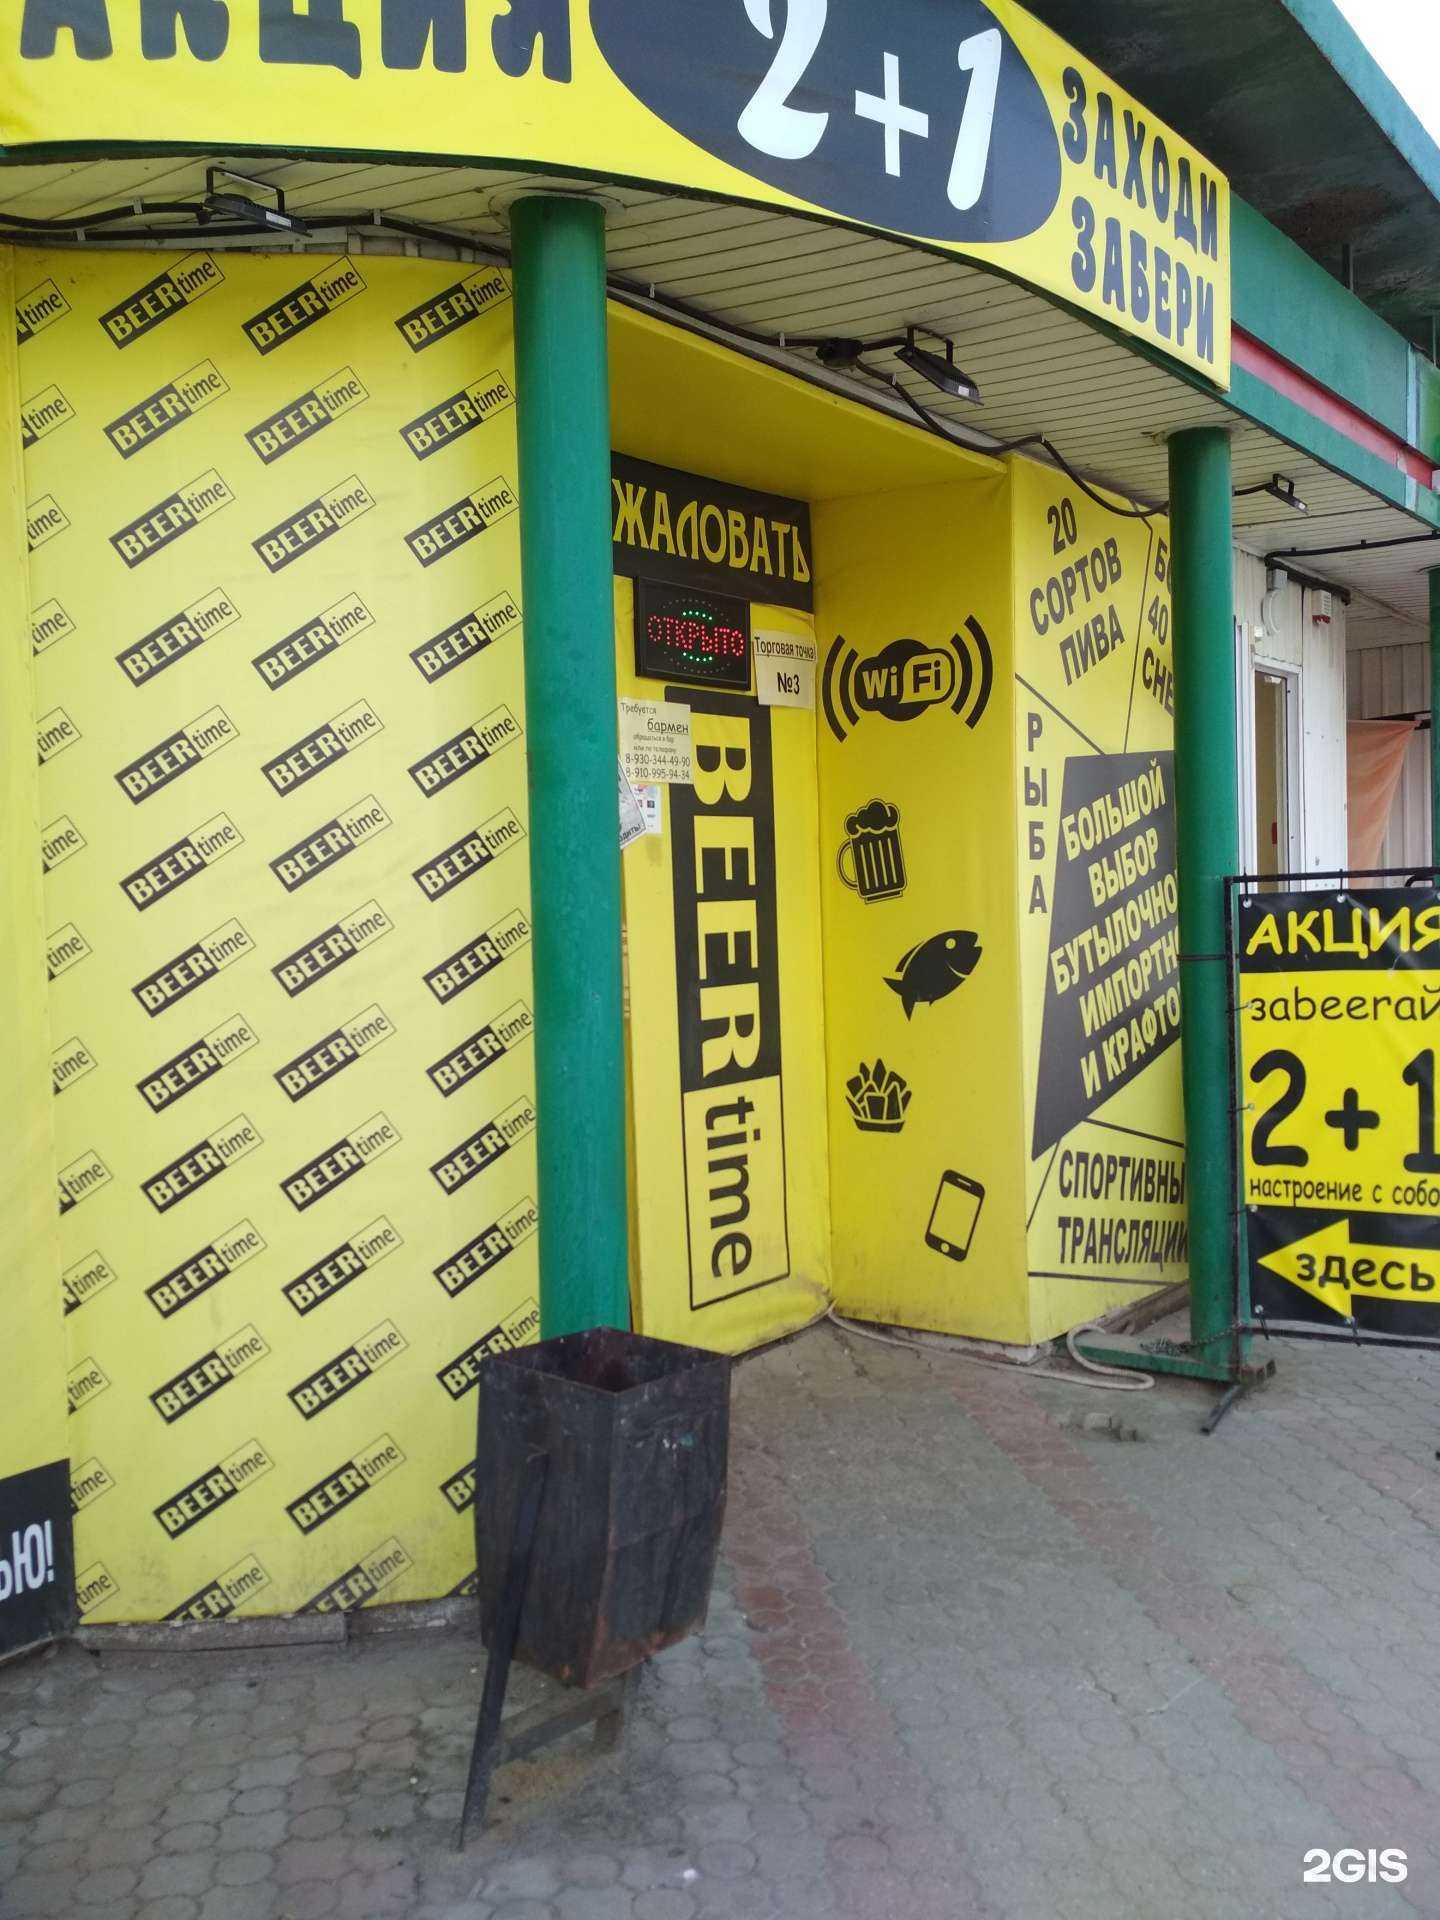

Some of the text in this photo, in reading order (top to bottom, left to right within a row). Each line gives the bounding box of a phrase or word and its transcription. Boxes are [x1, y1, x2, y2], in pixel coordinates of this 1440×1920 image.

[1063, 66, 1218, 262] ЗАХОДИ
[104, 257, 221, 344] BEERtime
[247, 263, 363, 351] BEERtime
[401, 274, 508, 348] BEERtime
[1071, 196, 1214, 364] ЗАБЕРИ
[109, 366, 226, 454] BEERtime
[250, 373, 365, 460] BEERtime
[405, 377, 515, 455] BEERtime
[115, 476, 231, 563] BEERtime
[258, 483, 372, 568] BEERtime
[410, 484, 516, 563] BEERtime
[612, 478, 811, 583] ЖАЛОВАТЬ
[1047, 498, 1077, 556] 20
[1030, 537, 1122, 636] СОРТОВ
[121, 595, 237, 682] BEERtime
[258, 600, 372, 686] BEERtime
[415, 598, 520, 678] BEERtime
[647, 615, 744, 656] ОТКРЫТО
[754, 636, 795, 657] Торговая
[1060, 604, 1124, 686] ПИВА
[620, 702, 657, 716] Требуется
[647, 717, 689, 734] бармен
[777, 672, 800, 695] №3
[120, 713, 235, 800] BEERtime
[267, 708, 380, 792] BEERtime
[413, 712, 519, 793] BEERtime
[274, 802, 388, 887] BEERtime
[1024, 713, 1047, 914] РЫБА
[1062, 758, 1166, 861] БОЛЬШОЙ
[125, 820, 241, 907] BEERtime
[418, 815, 522, 897] BEERtime
[1088, 827, 1159, 907] ВЫБОР
[137, 925, 252, 1013] BEERtime
[276, 907, 391, 992] BEERtime
[428, 915, 528, 999] BEERtime
[1051, 870, 1178, 995] БУТЫЛОЧНО
[1245, 906, 1440, 959] АКЦИЯ
[690, 711, 763, 1281] BEERtime
[141, 1020, 255, 1108] BEERtime
[279, 1010, 392, 1097] BEERtime
[432, 1008, 534, 1092] BEERtime
[1080, 982, 1181, 1099] И КРАФТО
[146, 1121, 260, 1209] BEERtime
[285, 1118, 397, 1207] BEERtime
[435, 1106, 536, 1190] BEERtime
[1250, 1177, 1363, 1208] настроение
[1372, 1184, 1383, 1204] с
[151, 1226, 263, 1314] BEERtime
[287, 1223, 399, 1311] BEERtime
[439, 1206, 537, 1293] BEERtime
[1296, 1252, 1435, 1293] здесь
[155, 1331, 267, 1419] BEERtime
[293, 1326, 405, 1415] BEERtime
[158, 1446, 271, 1534] BEERtime
[291, 1441, 402, 1530] BEERtime
